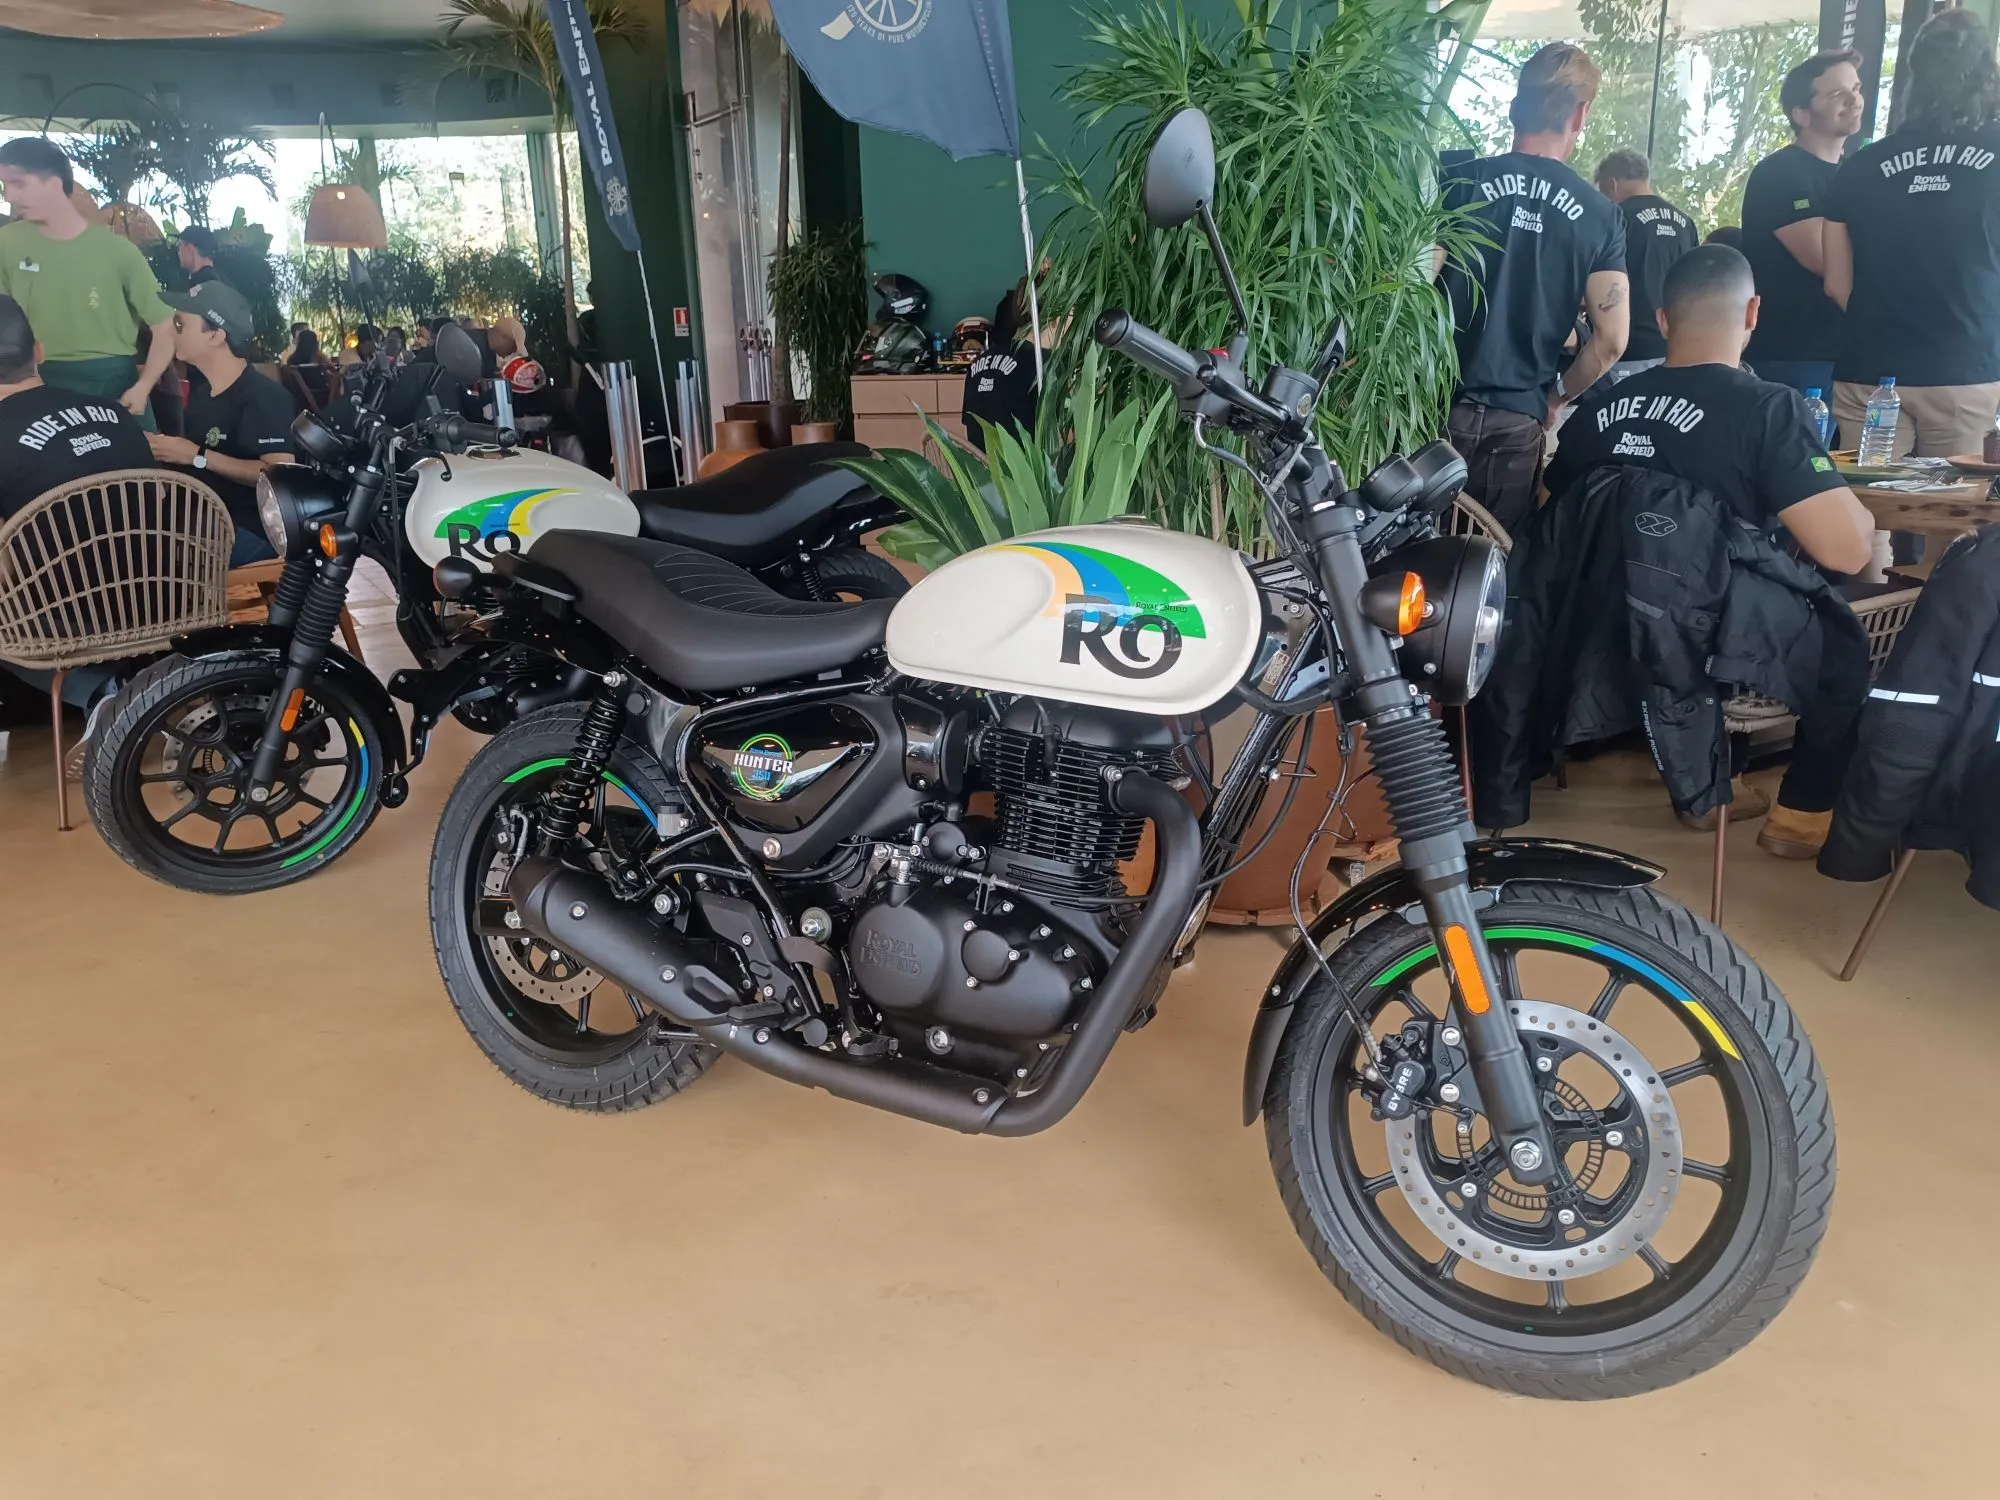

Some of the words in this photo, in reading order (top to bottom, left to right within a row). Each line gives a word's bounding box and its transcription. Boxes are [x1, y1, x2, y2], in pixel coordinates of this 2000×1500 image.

[856, 16, 875, 38] YEARS
[877, 32, 886, 41] OF
[1841, 0, 1858, 50] NFIE
[1880, 147, 1928, 178] RIDE
[1933, 145, 1957, 164] IN
[1957, 145, 1995, 170] RIO
[1908, 182, 1950, 193] ENFIELD
[1913, 174, 1947, 184] ROYAL
[1480, 174, 1527, 201] RIDE
[1529, 177, 1551, 201] IN
[1551, 187, 1584, 221] RIO
[1514, 206, 1542, 222] ROYAL
[1636, 208, 1660, 224] RIDE
[1659, 208, 1671, 220] IN
[1673, 211, 1686, 228] RIO
[1511, 216, 1543, 233] ENFIELD
[1596, 396, 1647, 433] RIDE
[1644, 396, 1672, 420] IN
[1664, 397, 1704, 433] RIO
[18, 414, 67, 451] RIDE
[58, 407, 88, 427] IN
[84, 405, 119, 424] RIO
[69, 432, 103, 447] ROYAL
[72, 438, 111, 457] ENFIELD
[1620, 432, 1652, 446] ROYAL
[1612, 444, 1655, 457] ENFIELD
[1136, 601, 1158, 610] ROYAL
[1160, 604, 1188, 613] ENFIELD
[733, 753, 793, 774] HUNTER
[753, 769, 771, 781] 350
[863, 929, 917, 959] ROYAL
[1387, 1067, 1413, 1112] BYBRE
